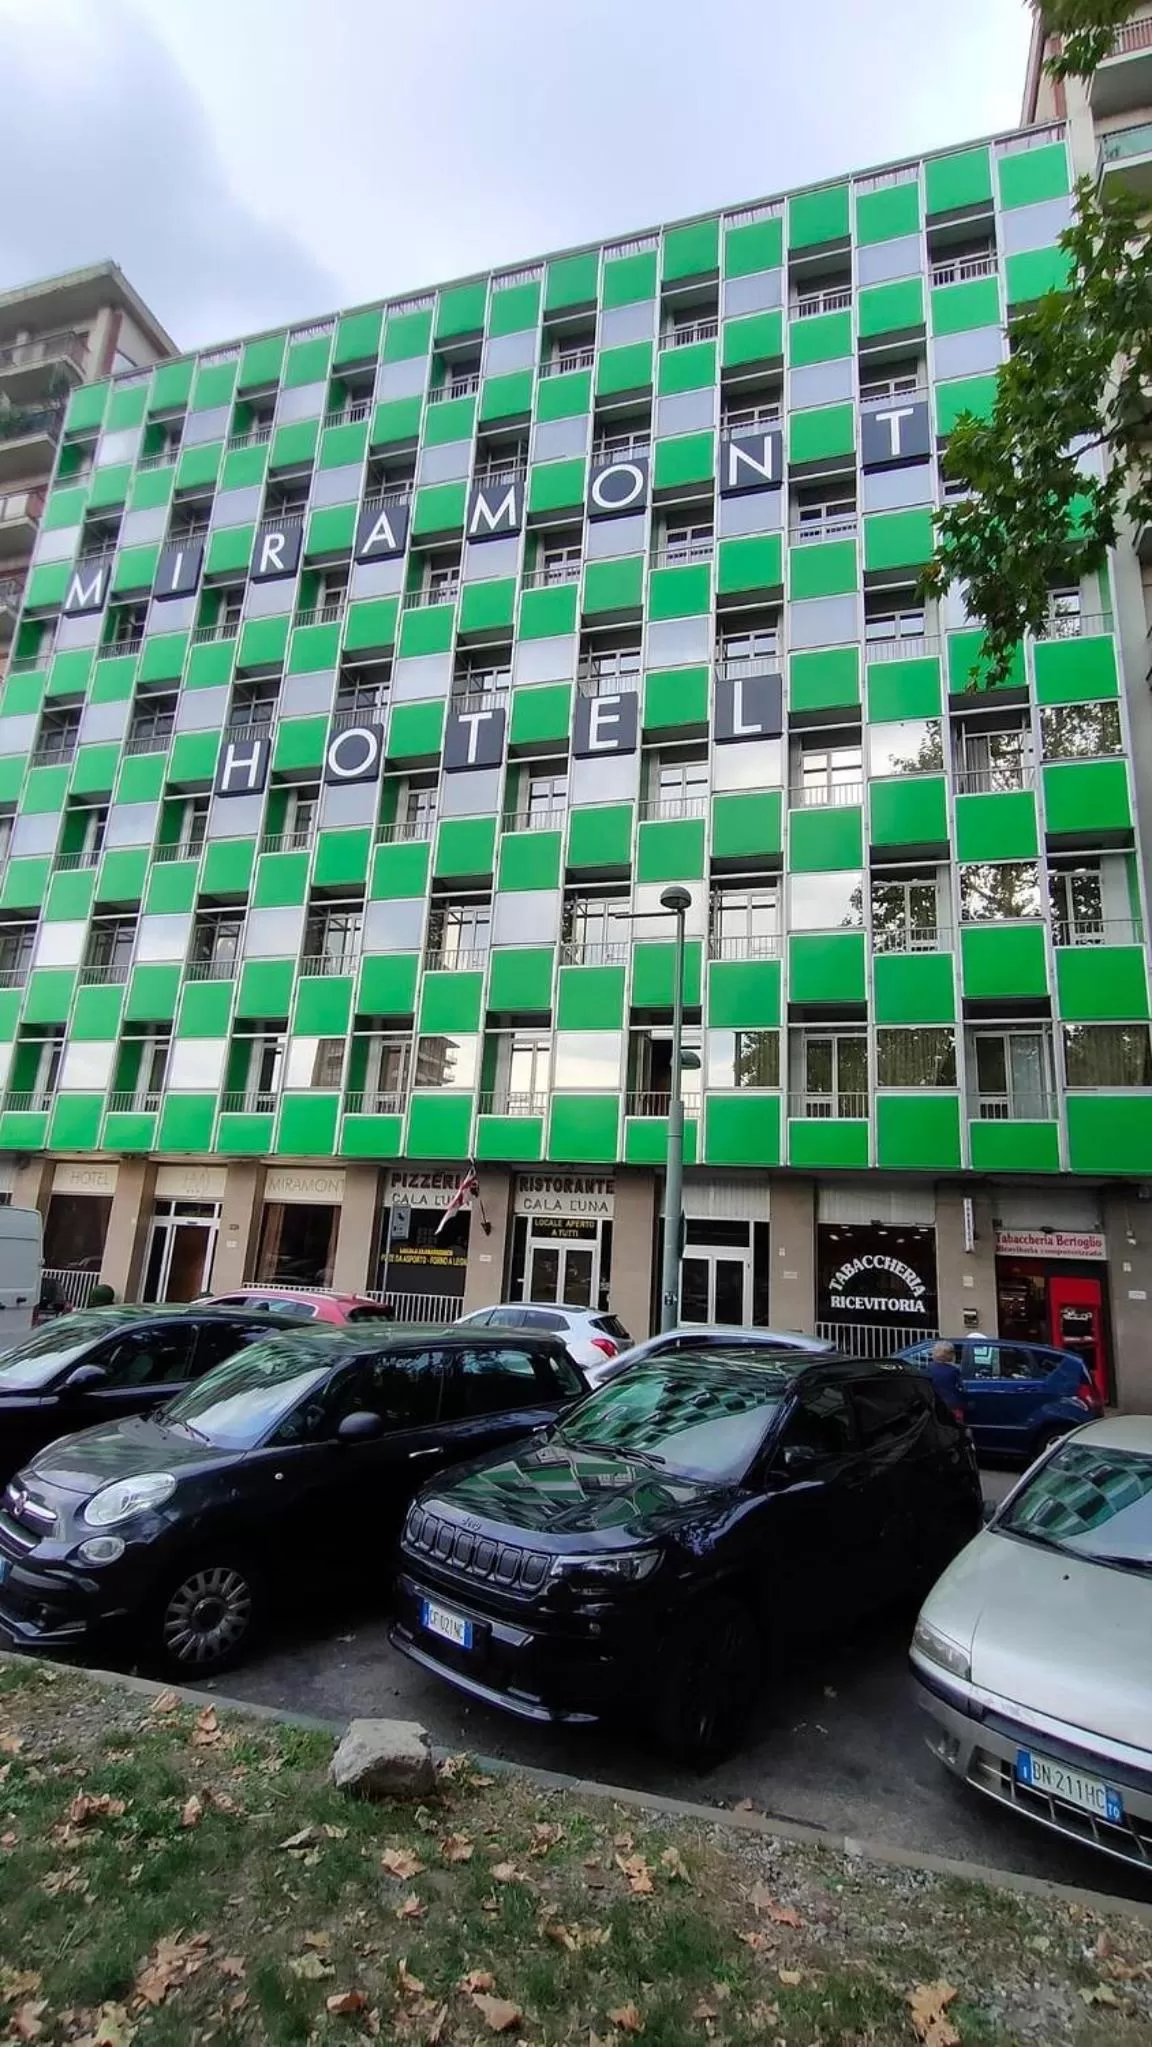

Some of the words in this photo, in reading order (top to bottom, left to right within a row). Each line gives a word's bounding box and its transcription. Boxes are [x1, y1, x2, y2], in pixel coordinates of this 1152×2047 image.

[65, 408, 914, 610] MIRAMONT
[221, 680, 762, 790] HOTEL
[71, 1170, 110, 1186] HOTEL
[391, 1172, 466, 1190] PIZZERI
[519, 1176, 615, 1194] RISTORANTE
[392, 1193, 428, 1206] CALA
[523, 1198, 562, 1211] CALA
[570, 1200, 609, 1213] LUNA
[534, 1218, 562, 1228] LOCALE
[565, 1219, 595, 1229] APERTO
[995, 1231, 1053, 1246] Tabaccheria
[829, 1254, 926, 1298] TABACCHERIA
[830, 1295, 926, 1313] RICEVITORIA
